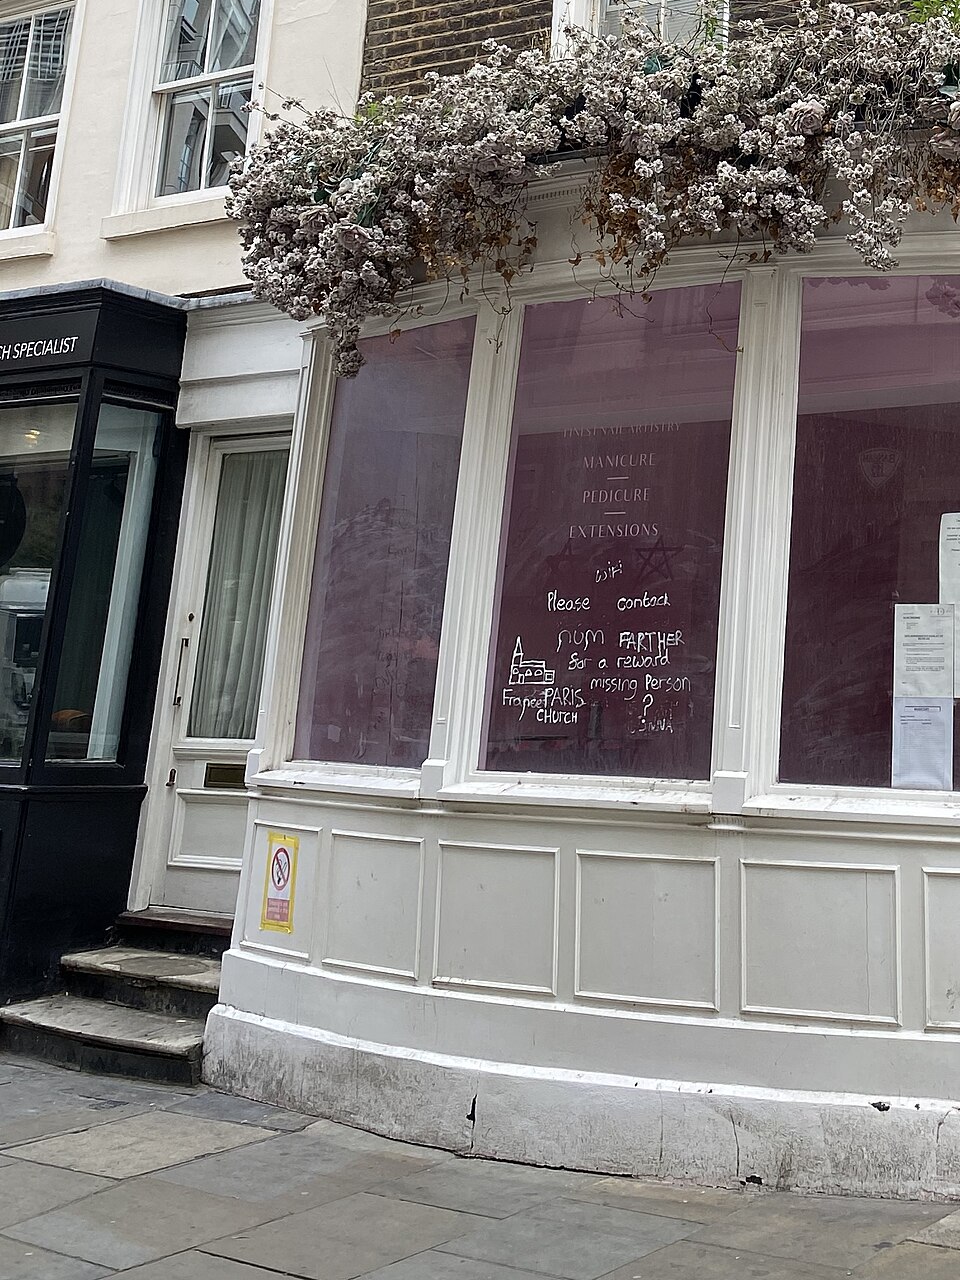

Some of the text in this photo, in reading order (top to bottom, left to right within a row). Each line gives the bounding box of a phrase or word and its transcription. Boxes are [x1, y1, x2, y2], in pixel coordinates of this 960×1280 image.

[12, 336, 79, 359] SPECIALIST
[630, 421, 681, 434] ARTISTRY
[583, 452, 657, 469] MANICURE
[582, 487, 651, 504] PEDICURE
[568, 522, 659, 539] EXTENSIONS
[546, 589, 591, 612] Please
[598, 658, 609, 669] a
[616, 649, 671, 668] reward
[590, 675, 638, 701] missing
